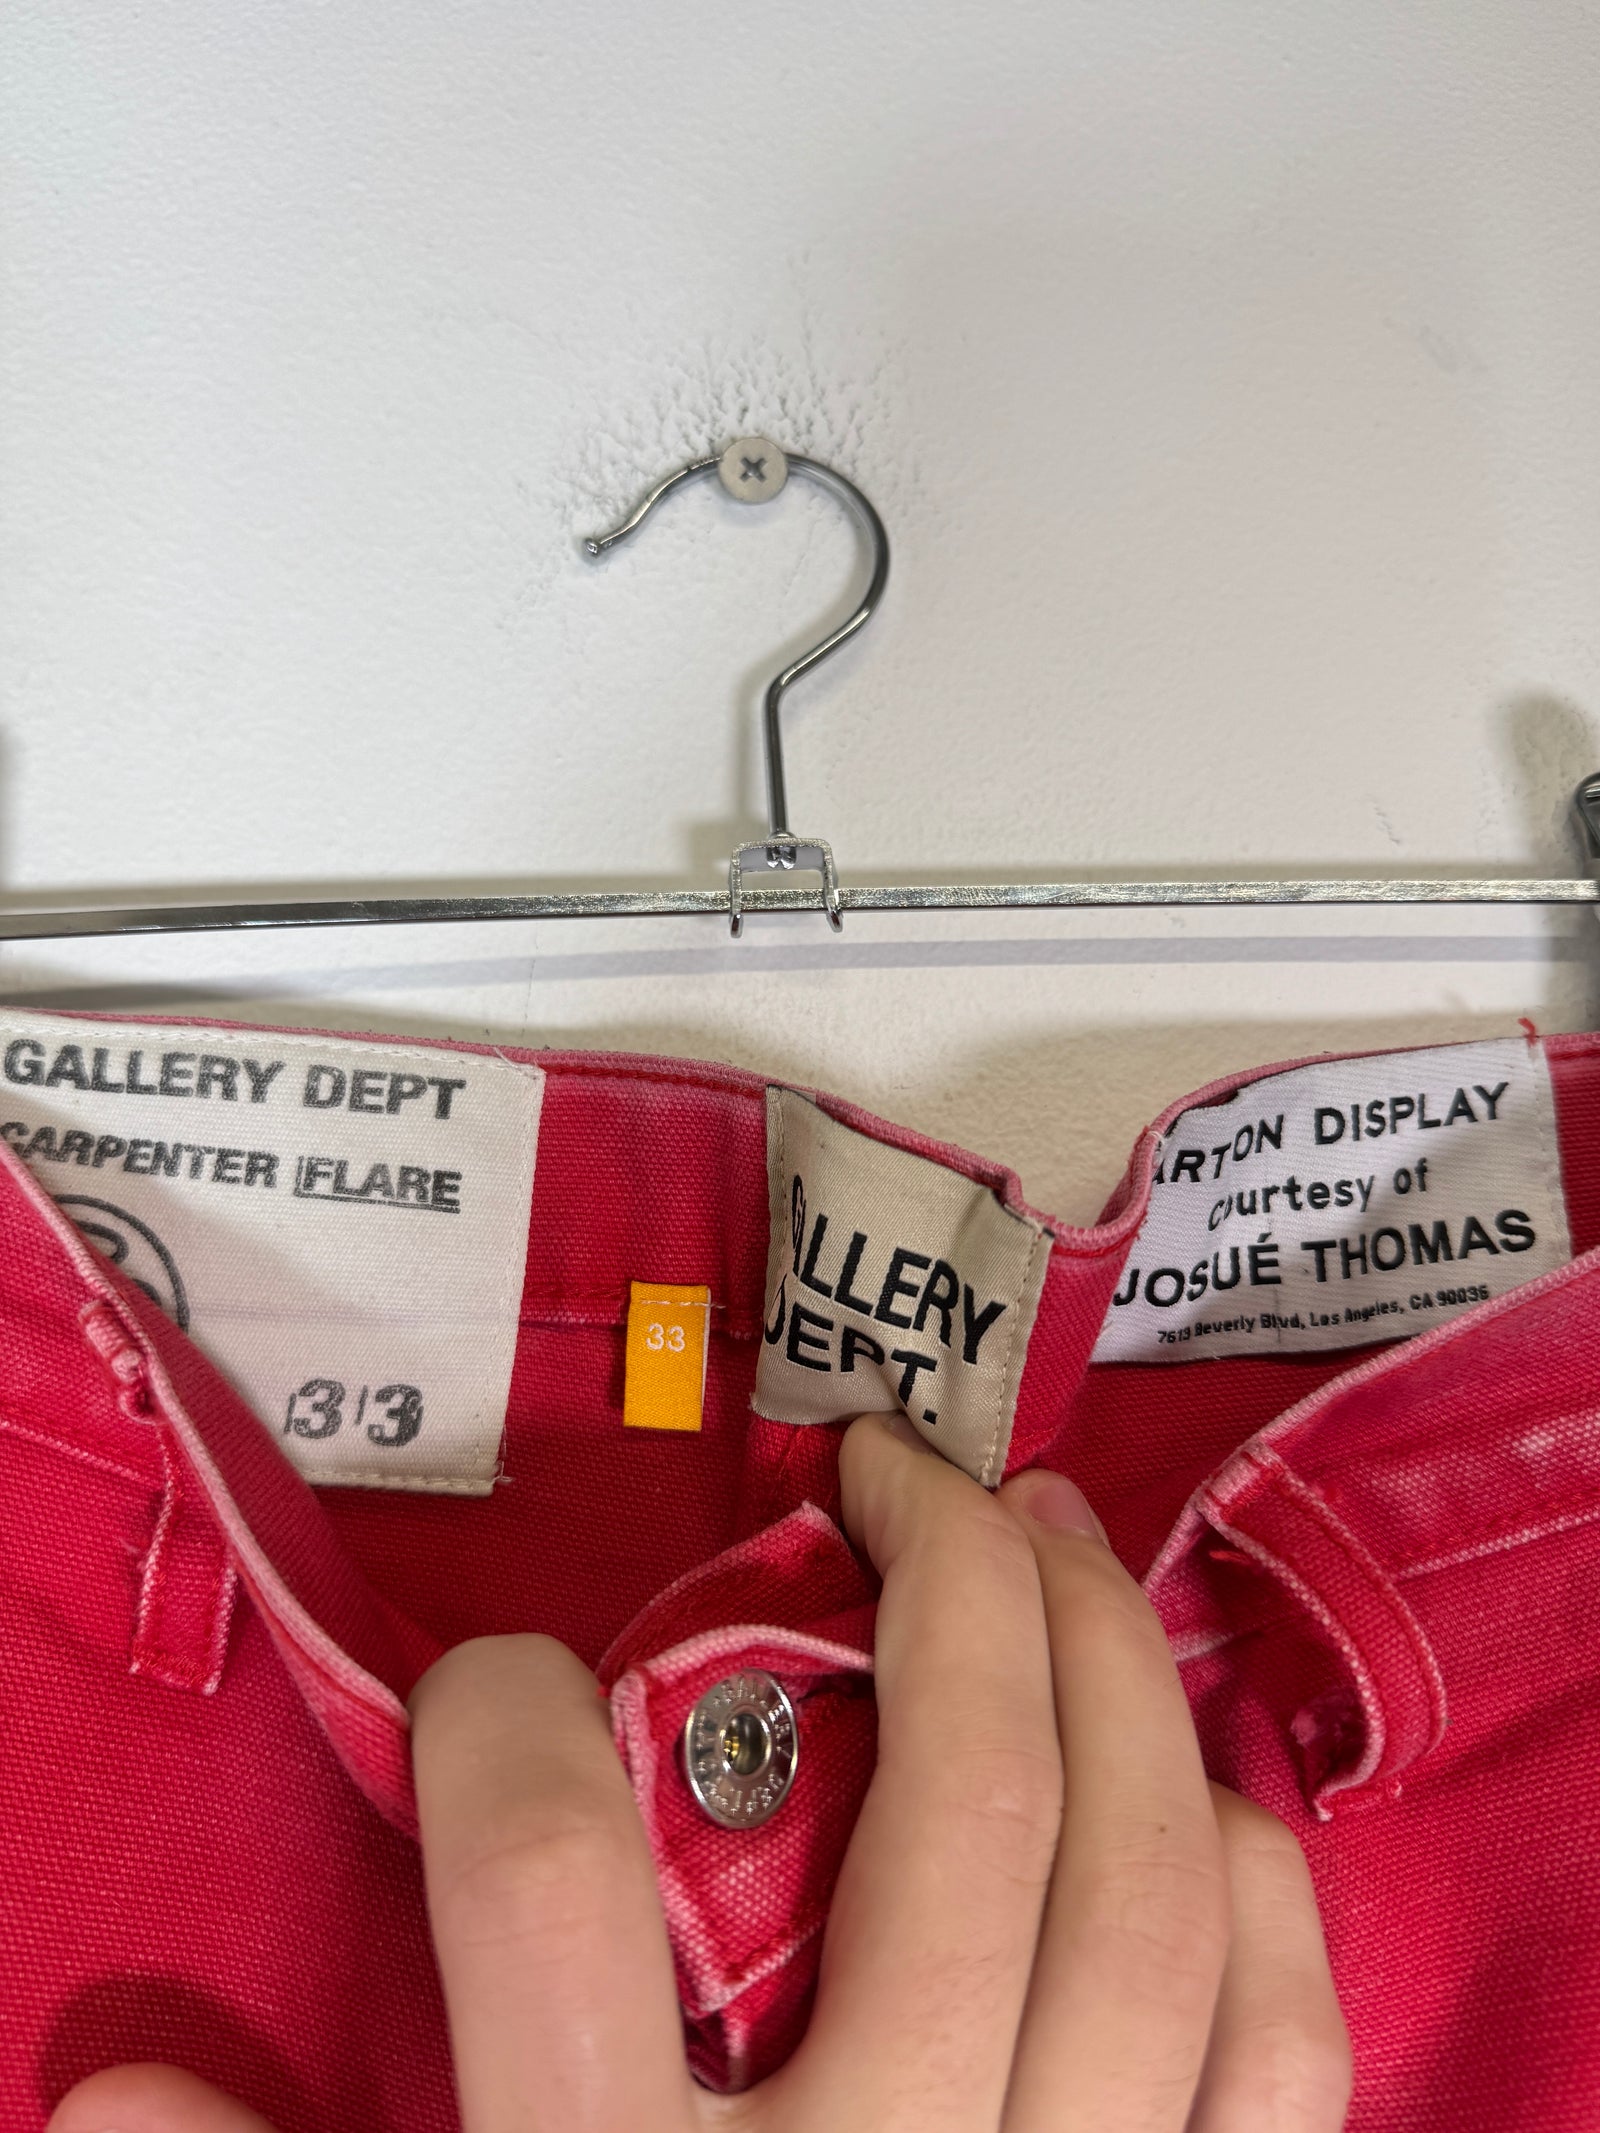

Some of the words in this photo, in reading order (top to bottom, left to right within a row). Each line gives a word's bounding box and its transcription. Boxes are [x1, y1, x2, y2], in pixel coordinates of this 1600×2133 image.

[4, 1038, 286, 1103] GALLERY
[302, 1064, 467, 1120] DEPT
[1313, 1082, 1510, 1146] DISPLAY
[0, 1121, 280, 1188] CARPENTER
[300, 1156, 462, 1208] FLARE
[1393, 1158, 1430, 1195] of
[1113, 1232, 1283, 1308] JOSUÉ
[1301, 1209, 1536, 1284] THOMAS
[645, 1322, 686, 1353] 33
[1194, 1314, 1256, 1334] Beverly
[1308, 1311, 1340, 1327] Los
[1344, 1299, 1406, 1323] Angeles,
[1408, 1292, 1434, 1311] CA
